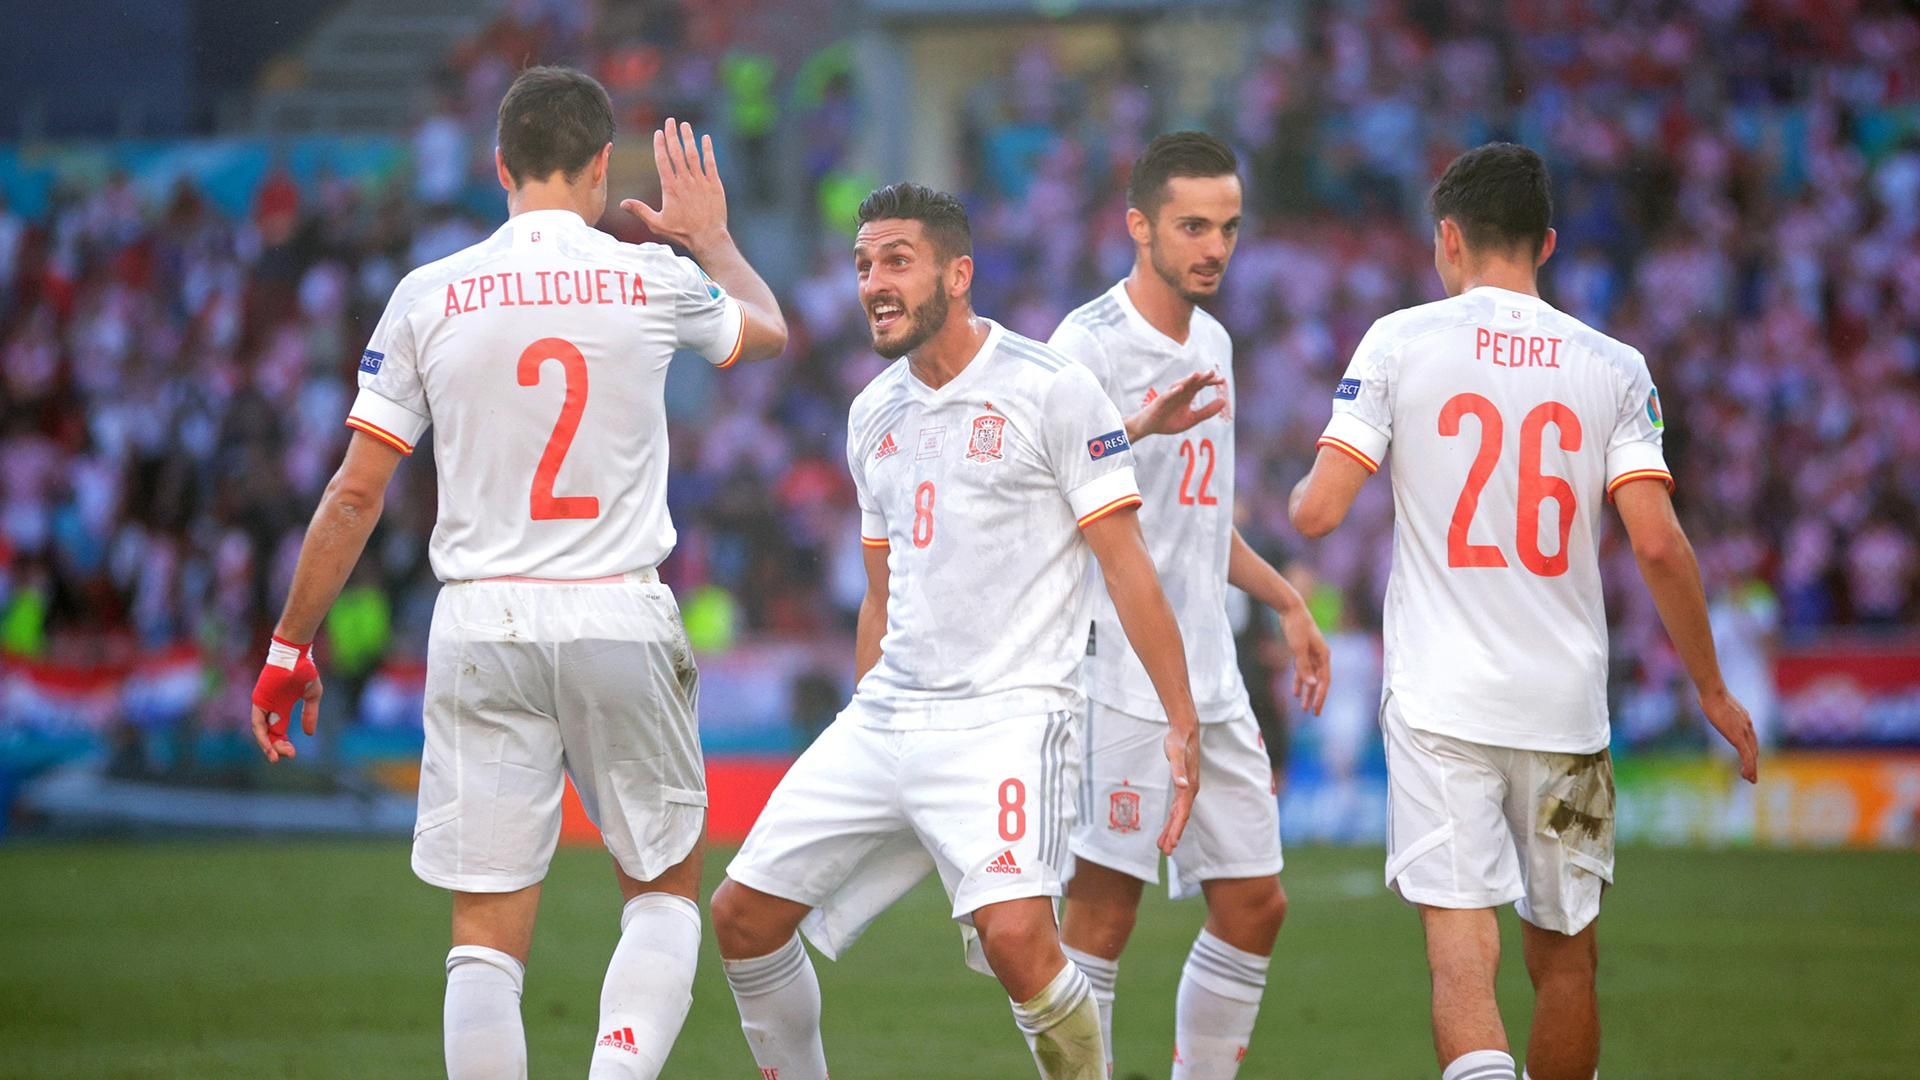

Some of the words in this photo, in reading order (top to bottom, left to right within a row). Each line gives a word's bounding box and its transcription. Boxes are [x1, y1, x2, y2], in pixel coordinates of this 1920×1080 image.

[445, 269, 647, 317] AZPILICUETA
[1476, 327, 1562, 369] PEDRI
[516, 337, 600, 521] 2
[875, 445, 898, 460] adidas
[1178, 437, 1218, 506] 22
[1438, 392, 1583, 578] 26
[913, 480, 936, 549] 8
[998, 778, 1026, 842] 8
[986, 864, 1022, 875] adidas
[598, 1037, 639, 1054] adidas
